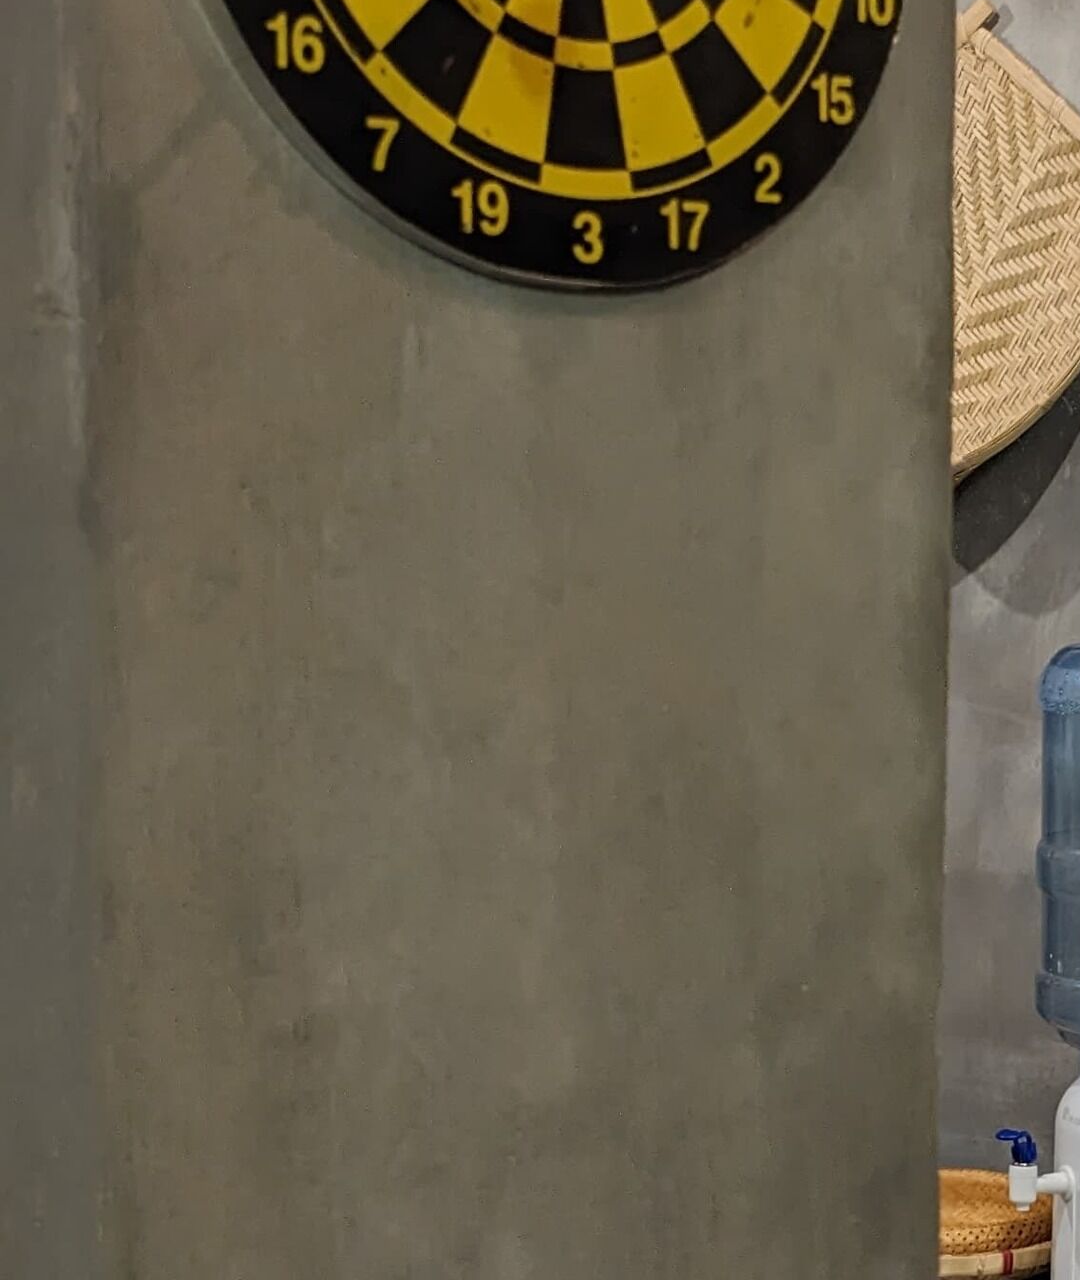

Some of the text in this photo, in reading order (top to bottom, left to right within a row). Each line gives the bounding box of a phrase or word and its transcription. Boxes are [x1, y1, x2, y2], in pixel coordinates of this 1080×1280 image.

[266, 13, 325, 73] 16
[811, 73, 855, 125] 15
[366, 117, 399, 171] 7
[755, 153, 781, 204] 2
[452, 180, 509, 236] 19
[660, 198, 709, 251] 17
[573, 211, 604, 264] 3
